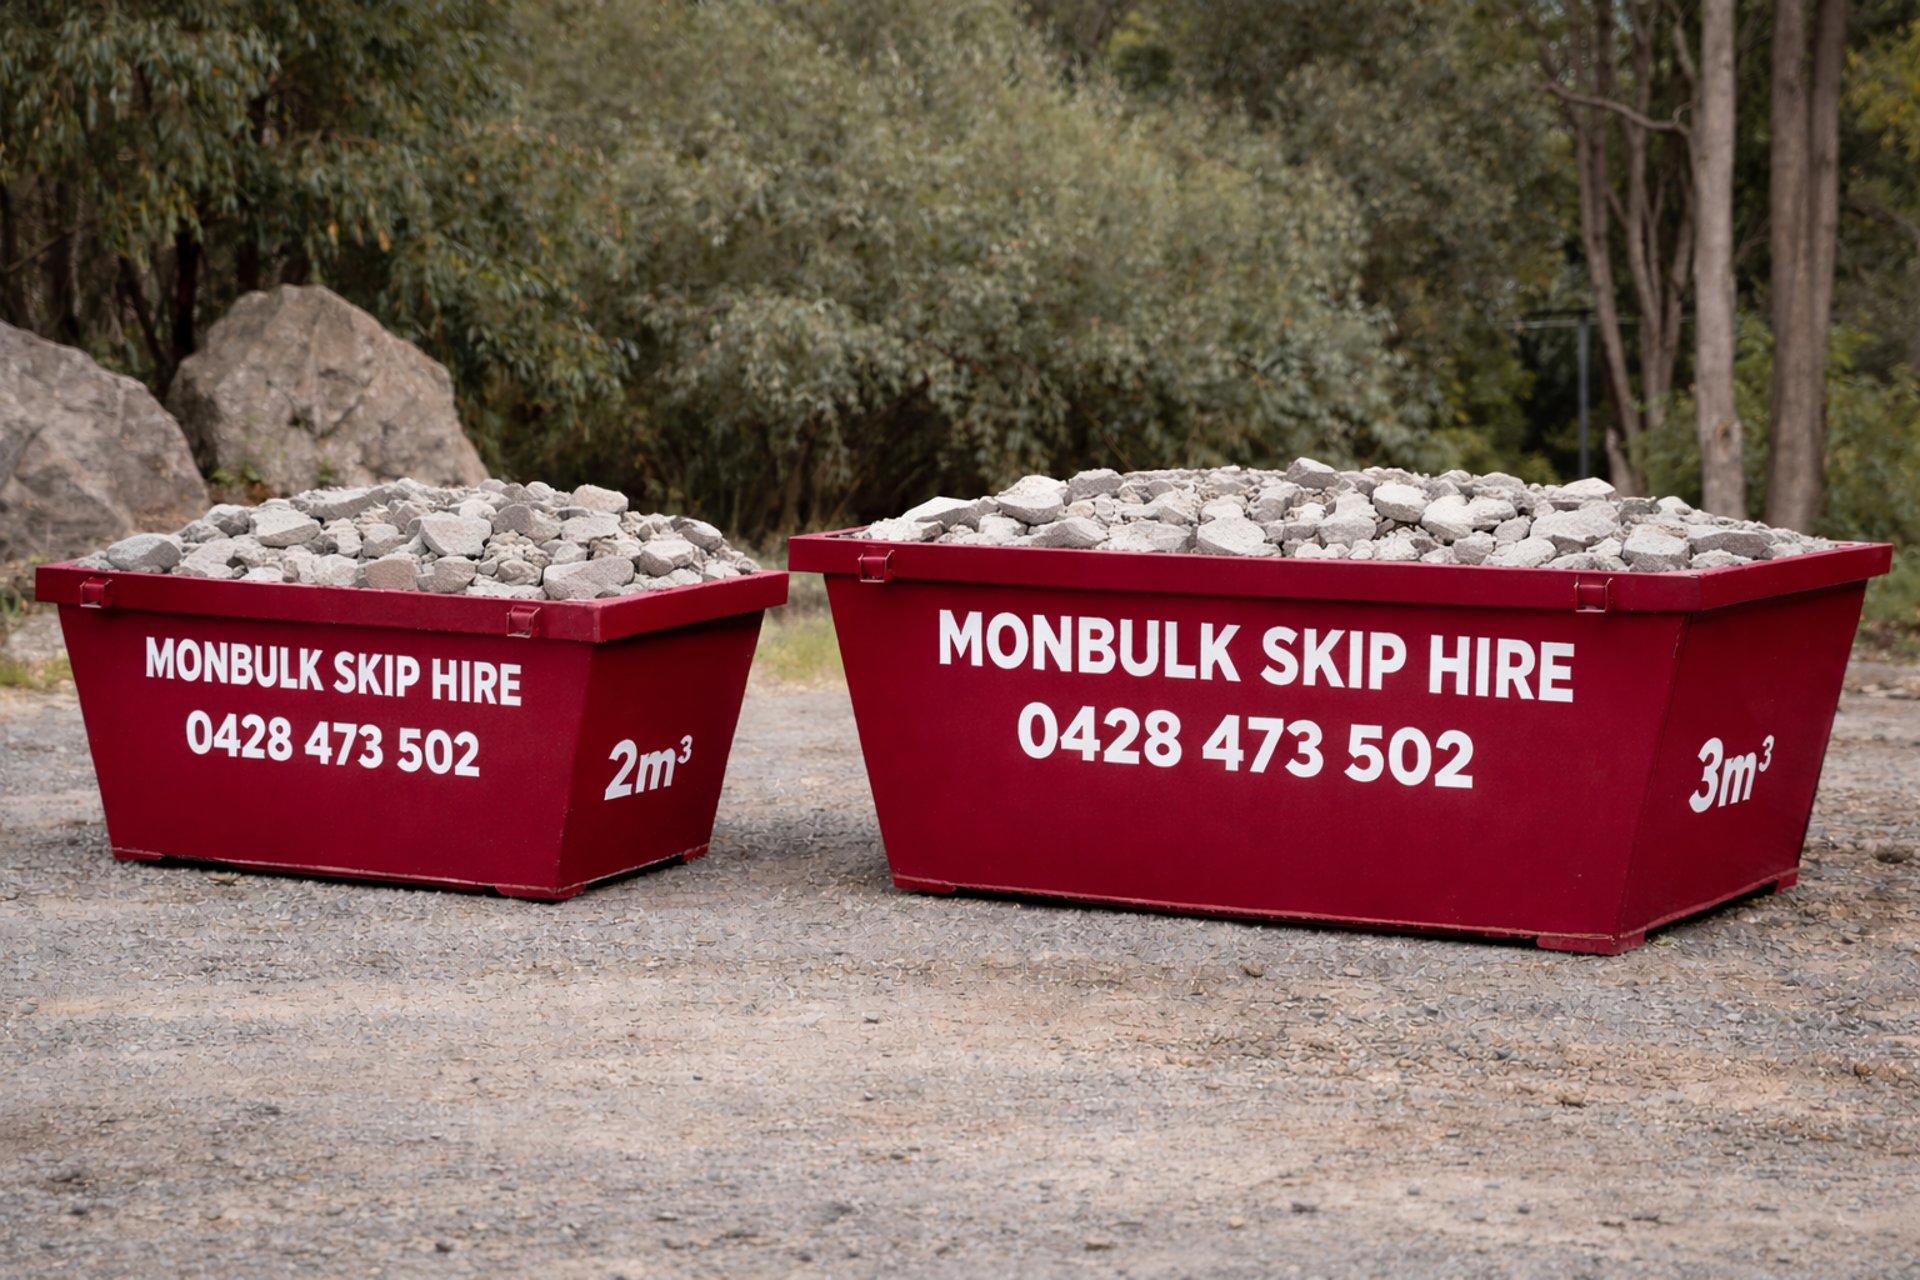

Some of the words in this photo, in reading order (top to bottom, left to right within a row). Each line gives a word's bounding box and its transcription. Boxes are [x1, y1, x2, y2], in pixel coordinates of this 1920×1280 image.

[145, 636, 325, 692] MONBULK
[333, 650, 421, 698] SKIP
[431, 658, 522, 707] HIRE
[939, 609, 1242, 682] MONBULK
[1260, 625, 1407, 691] SKIP
[1428, 634, 1575, 703] HIRE
[185, 709, 293, 762] 0428
[303, 720, 384, 769] 473
[396, 727, 480, 778] 502
[604, 734, 694, 801] 2m³
[1017, 701, 1183, 768] 0428
[1201, 714, 1324, 778] 473
[1343, 723, 1474, 789] 502
[1688, 734, 1775, 813] 3m³
